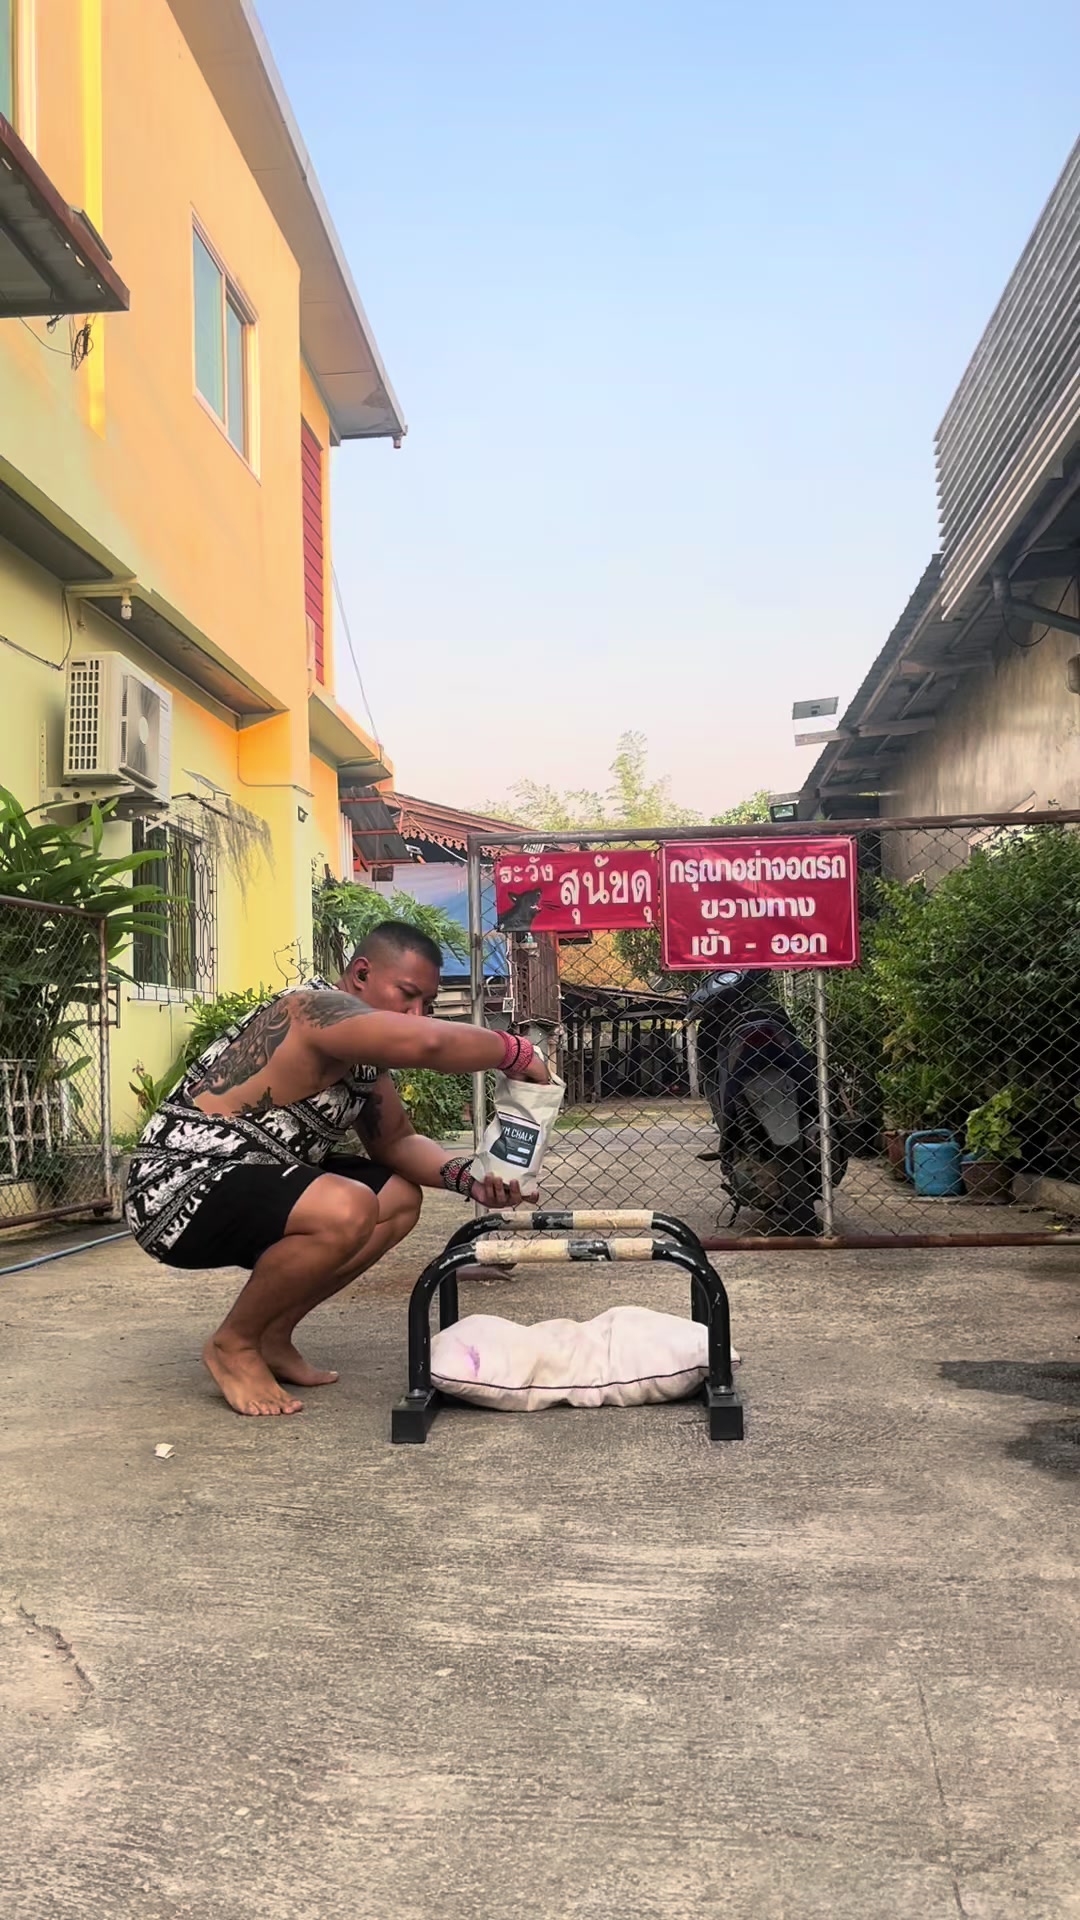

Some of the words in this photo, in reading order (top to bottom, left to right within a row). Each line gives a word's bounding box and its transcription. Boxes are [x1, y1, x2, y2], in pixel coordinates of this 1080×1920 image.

[669, 850, 847, 892] กรุณาอย่าจอดรถ
[499, 856, 553, 883] ระวัง
[558, 854, 652, 925] สุนัขดุ
[701, 896, 816, 919] ขวางทาง
[691, 928, 731, 956] เข้า
[771, 932, 828, 954] ออก
[511, 1128, 534, 1142] CHALK
